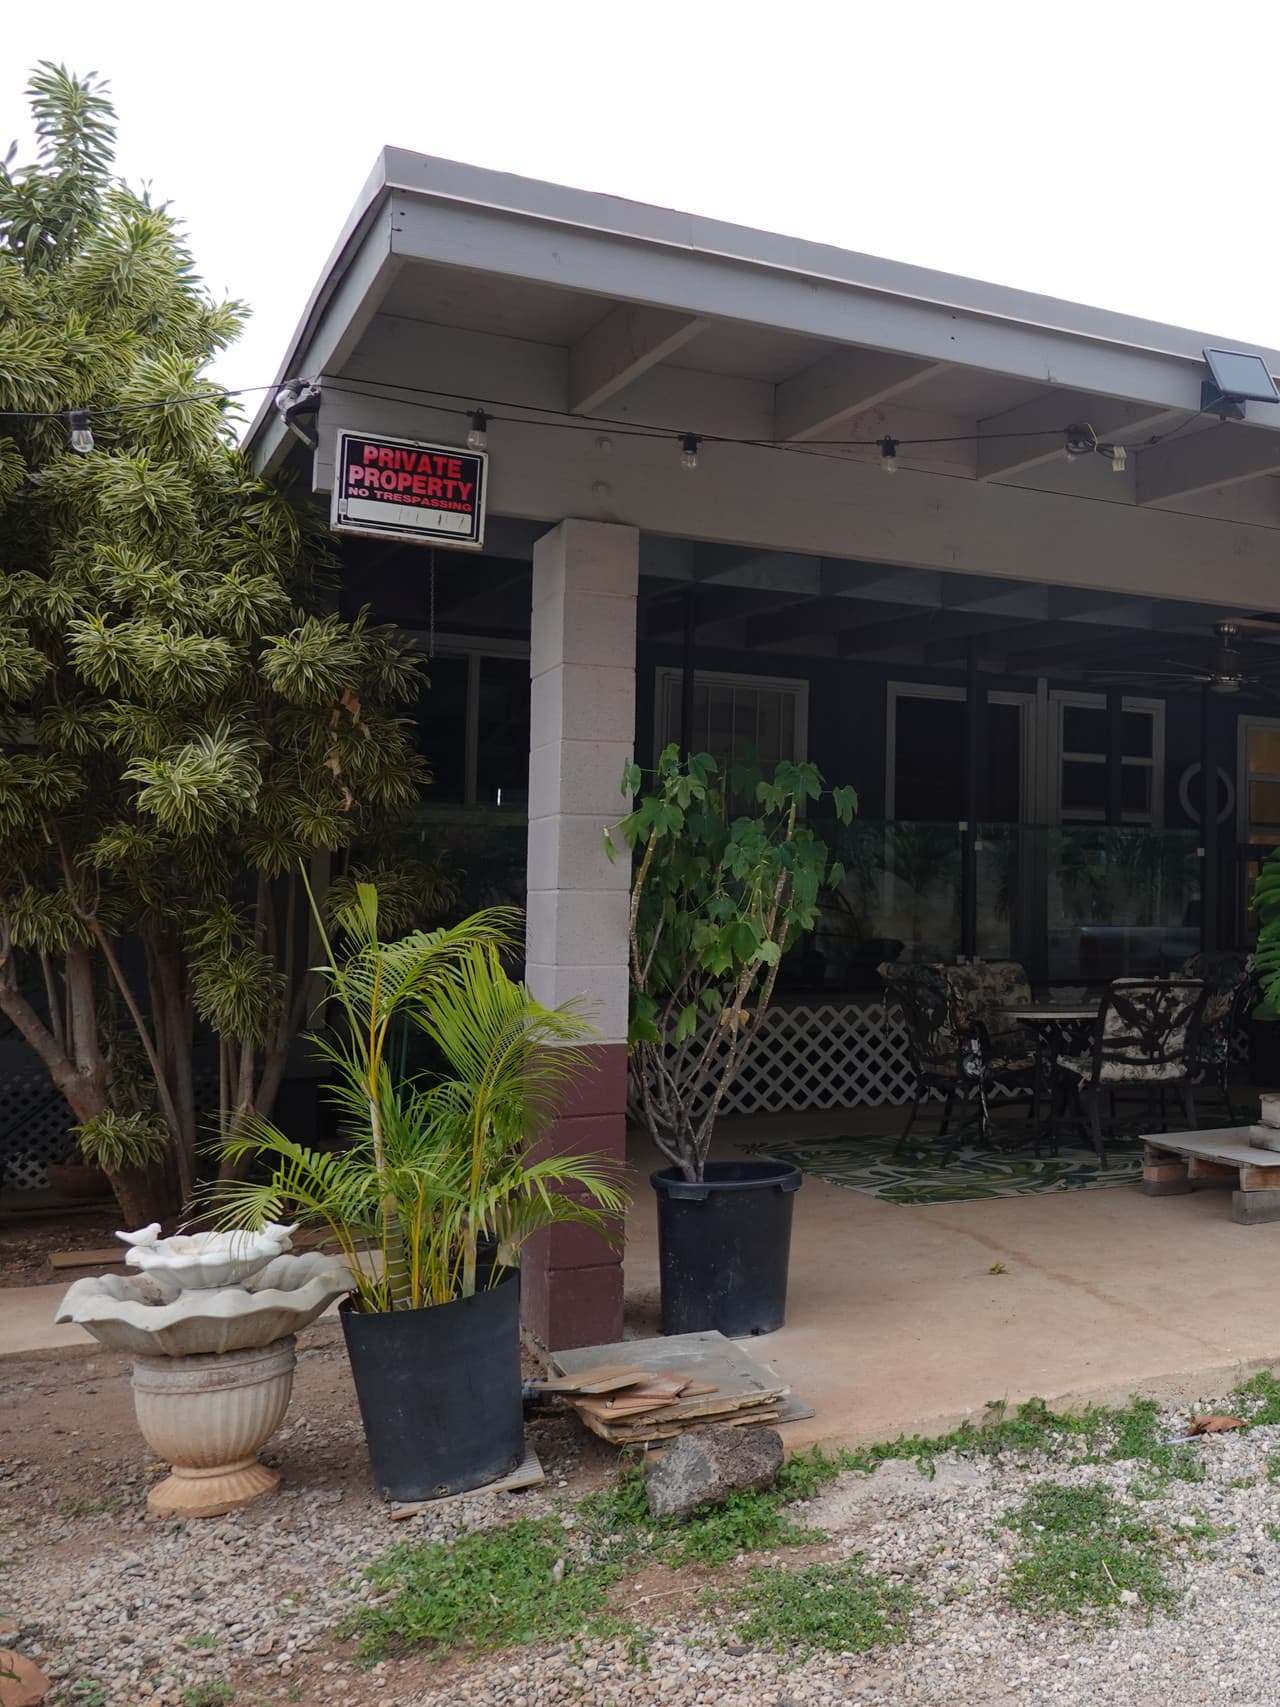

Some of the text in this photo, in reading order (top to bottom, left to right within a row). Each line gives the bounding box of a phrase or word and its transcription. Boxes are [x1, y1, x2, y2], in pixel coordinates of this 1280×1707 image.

[363, 445, 463, 477] PRIVATE
[349, 465, 473, 501] PROPERTY
[348, 487, 472, 512] NO TRESPASSING
